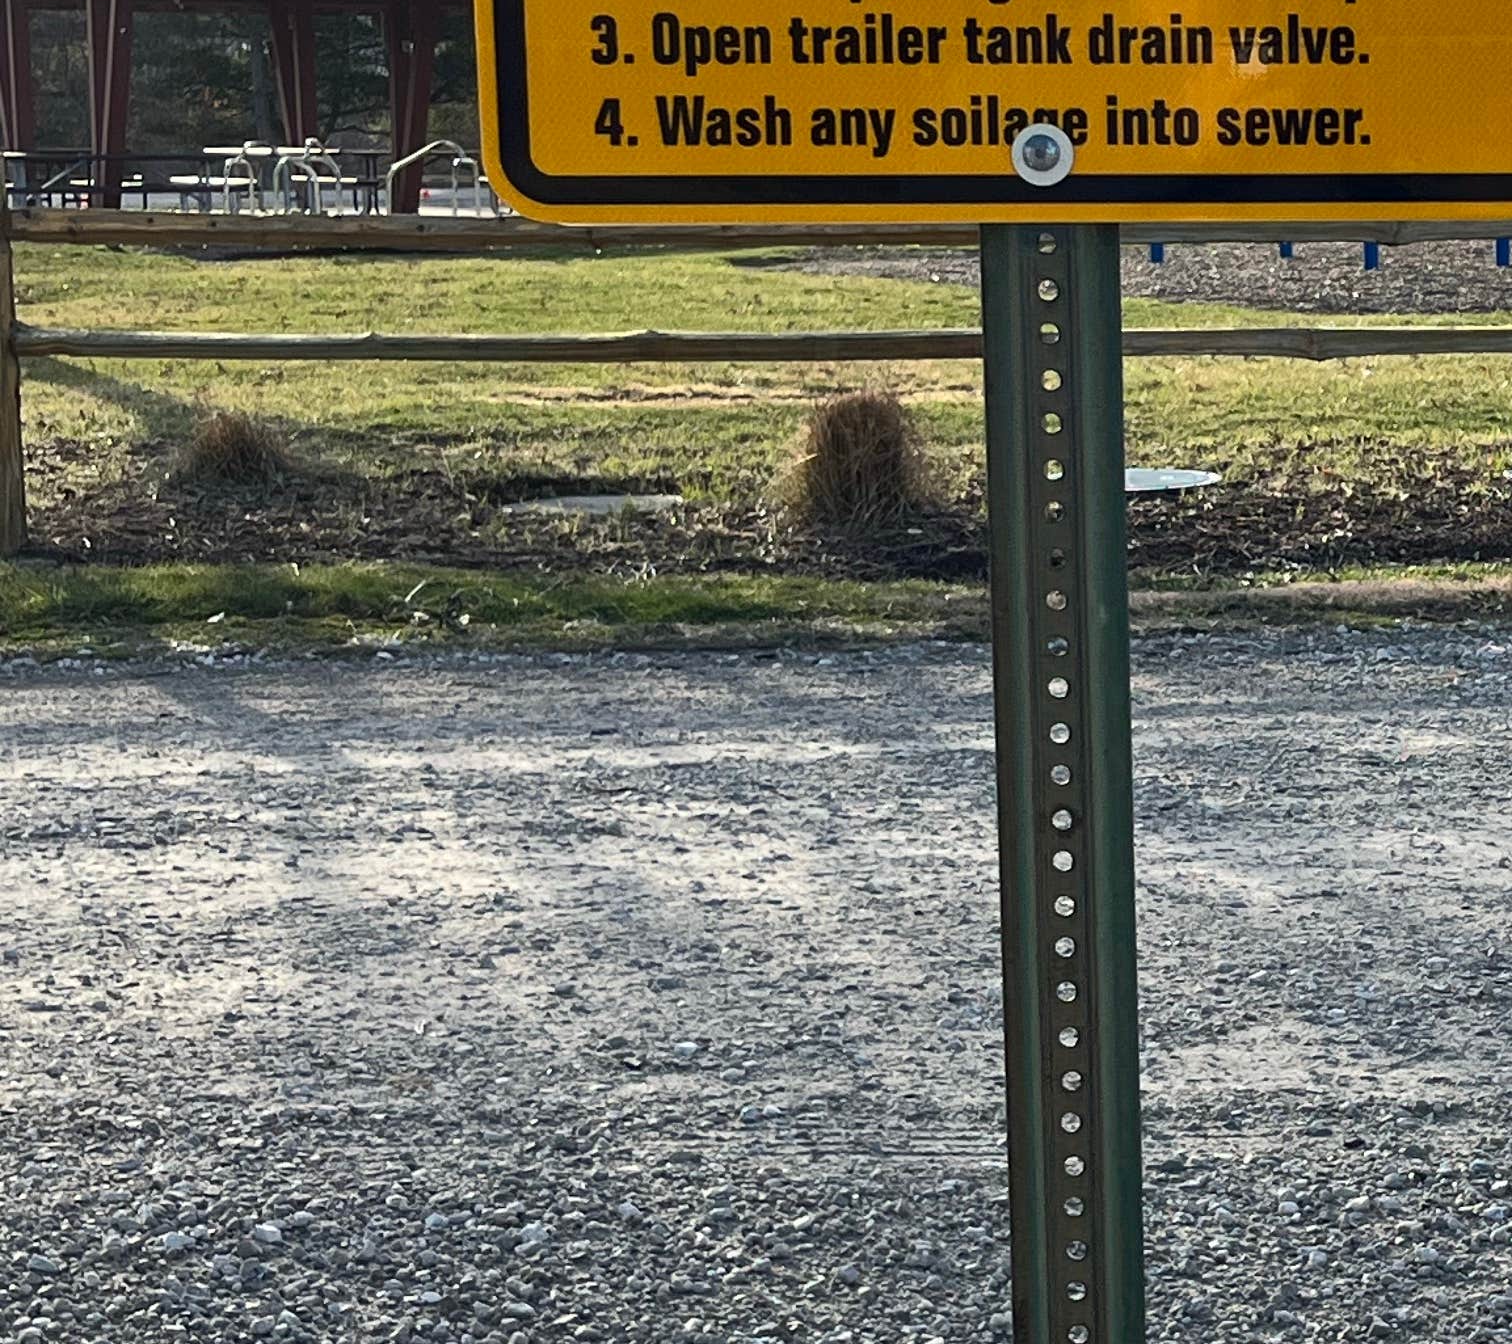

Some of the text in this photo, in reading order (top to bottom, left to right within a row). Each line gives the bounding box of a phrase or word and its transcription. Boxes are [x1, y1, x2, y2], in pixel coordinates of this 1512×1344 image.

[590, 12, 1370, 77] 3. Open trailer tank drain valve.
[594, 97, 639, 147] 4.
[654, 94, 792, 147] Wash
[810, 107, 896, 158] any
[1105, 94, 1199, 147] into
[1216, 107, 1371, 147] sewer.
